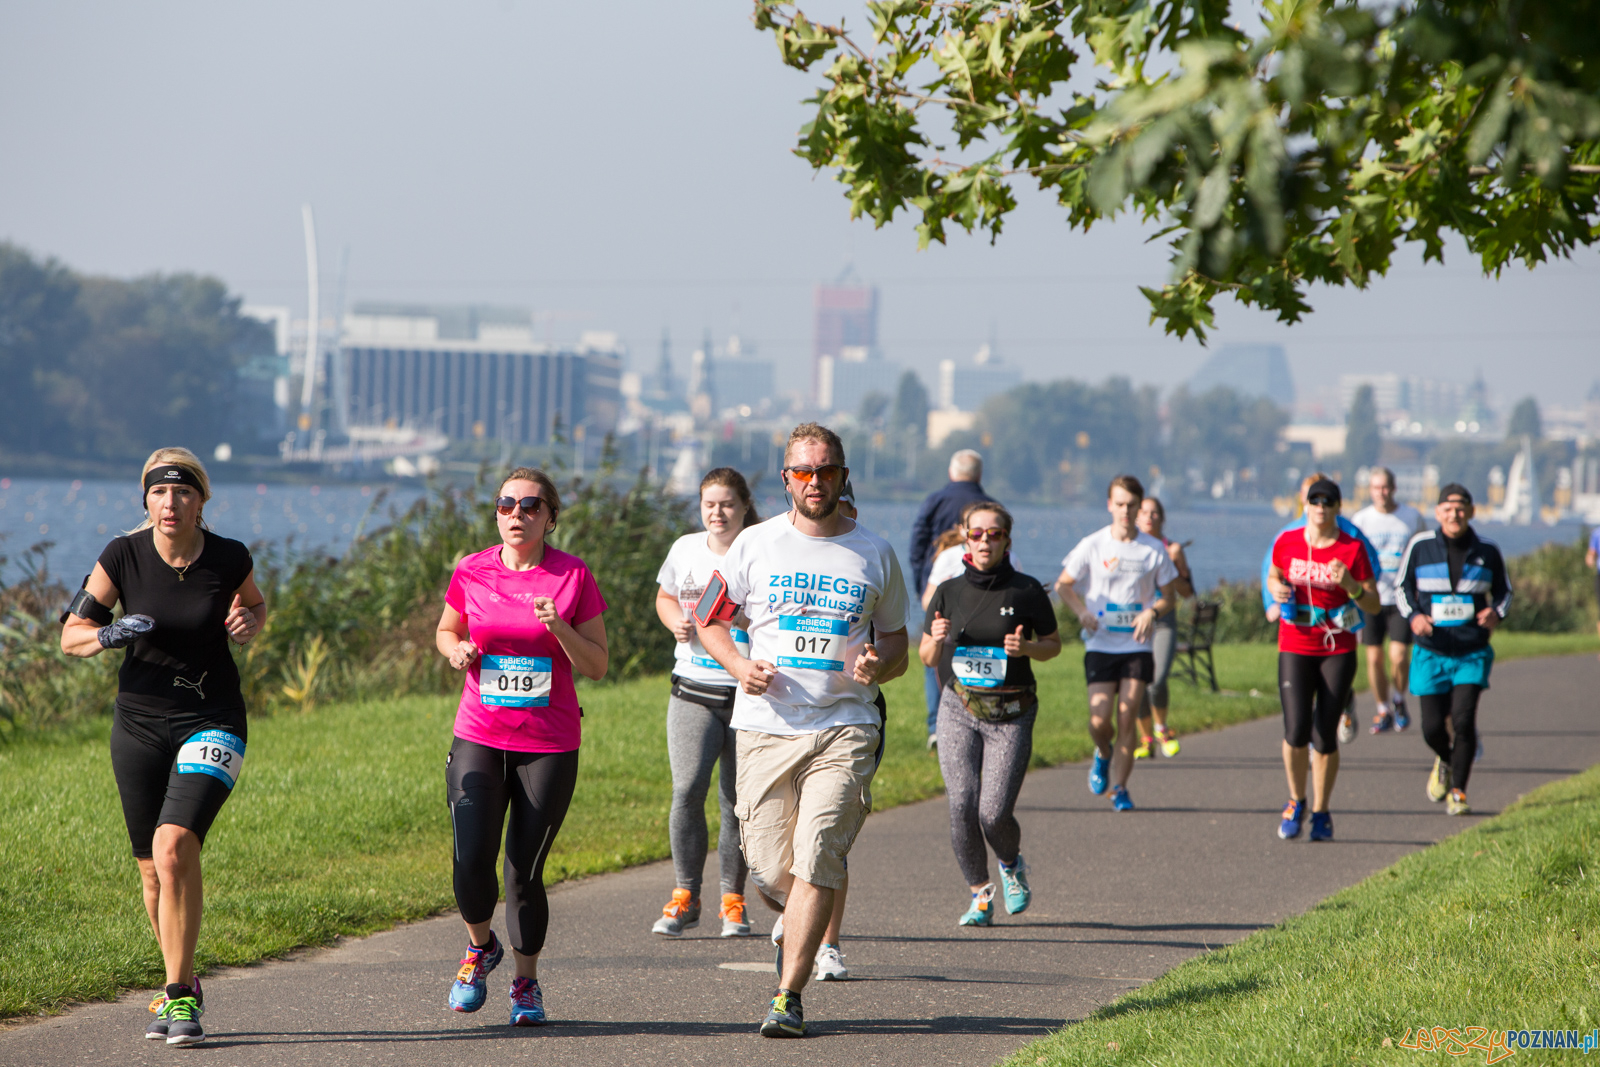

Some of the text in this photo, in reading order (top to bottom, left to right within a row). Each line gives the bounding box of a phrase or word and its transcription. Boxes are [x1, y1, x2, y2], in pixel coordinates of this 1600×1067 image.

[1288, 567, 1332, 584] SZPIK
[769, 572, 868, 604] zaBIEGaj
[769, 590, 864, 615] o FUNdusze
[796, 618, 833, 629] zaBIEGaj
[795, 635, 831, 655] 017
[499, 656, 535, 667] zaBIEGaj
[965, 660, 992, 675] 315
[498, 674, 533, 692] 019
[201, 730, 237, 746] zaBIEGaj
[199, 745, 232, 769] 192
